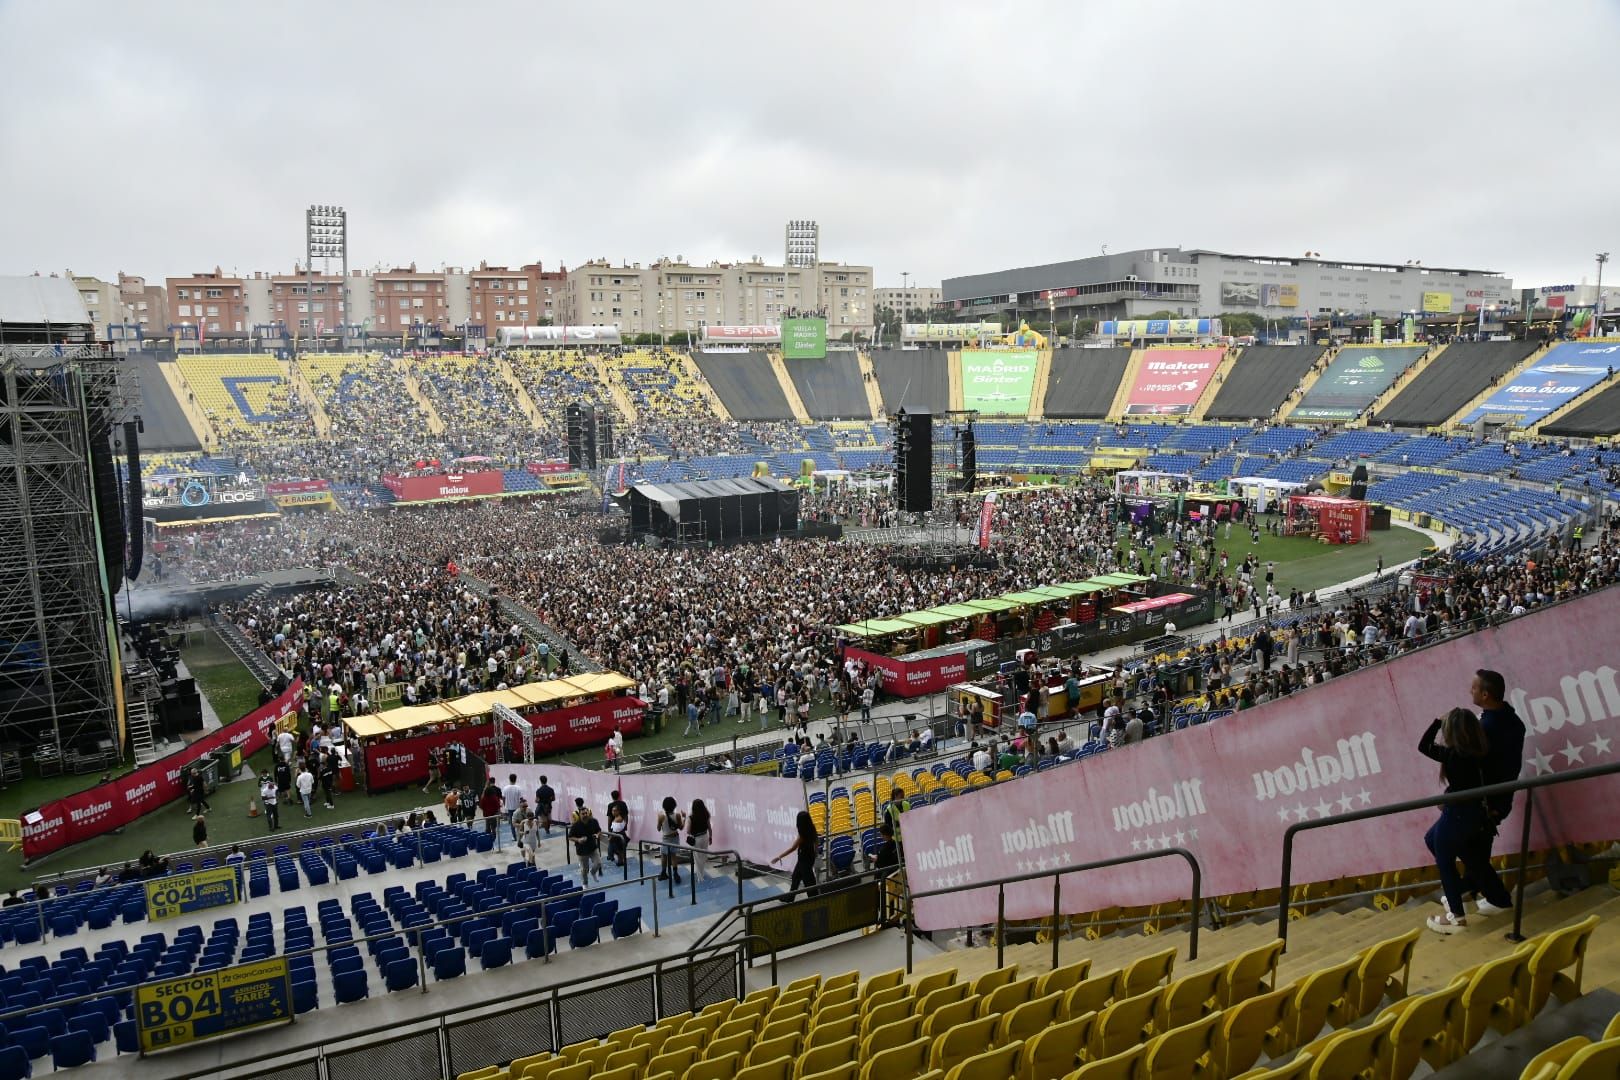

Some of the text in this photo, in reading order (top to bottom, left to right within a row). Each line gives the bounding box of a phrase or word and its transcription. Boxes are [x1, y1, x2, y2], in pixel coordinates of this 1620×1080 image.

[723, 327, 777, 335] SPAR
[967, 365, 1030, 373] MADRID
[1147, 361, 1210, 370] Mahou
[972, 375, 1023, 383] Binter
[1538, 386, 1581, 394] OLSEN
[440, 485, 470, 495] Mahou
[220, 491, 255, 503] IQOS
[906, 670, 931, 681] Mahou
[940, 664, 965, 675] Mahou
[568, 715, 601, 728] Mahou
[533, 724, 557, 736] ahou
[376, 753, 414, 768] Mahou
[125, 780, 157, 801] Mahou
[70, 800, 112, 822] Mahou
[158, 879, 192, 890] SECTOR
[152, 886, 195, 906] C04
[232, 965, 282, 981] GranCanaria
[155, 977, 215, 998] SECTOR
[235, 990, 271, 1005] PARES
[141, 990, 218, 1029] B04
